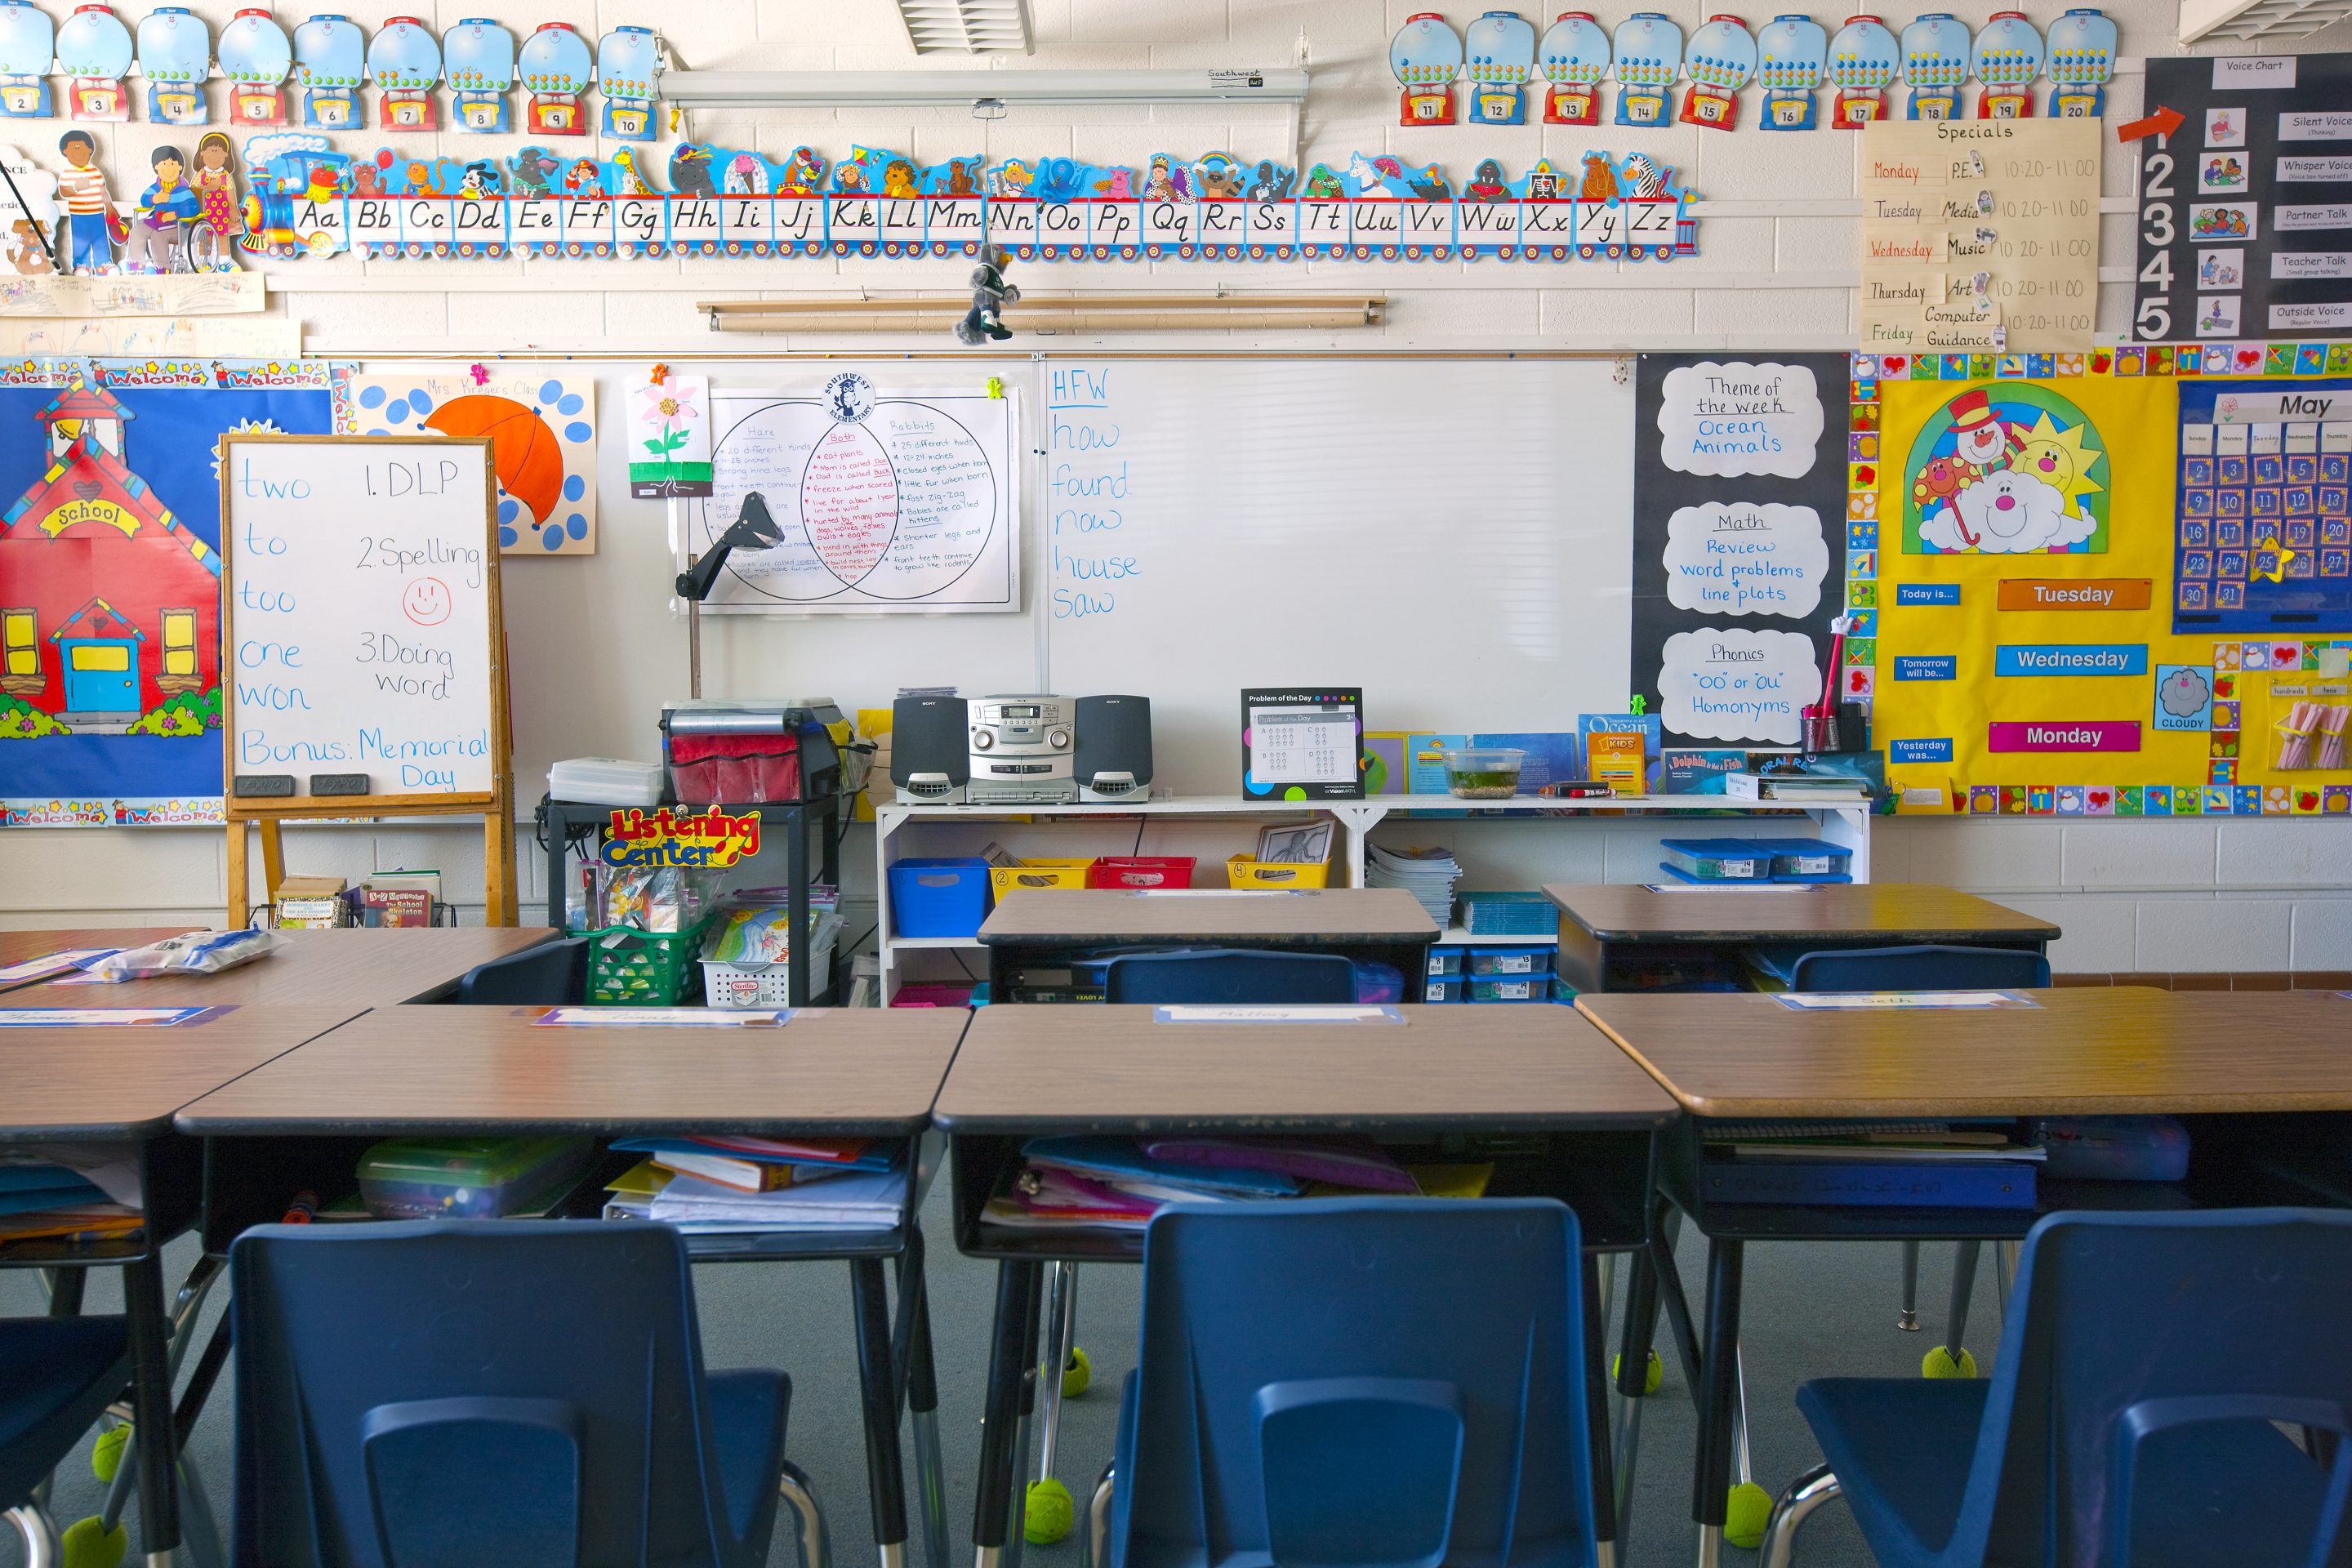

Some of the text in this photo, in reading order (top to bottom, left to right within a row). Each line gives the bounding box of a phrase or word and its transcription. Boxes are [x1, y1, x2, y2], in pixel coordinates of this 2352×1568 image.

[2226, 60, 2284, 71] Voice Chart
[17, 98, 25, 109] 2
[173, 105, 182, 116] 4
[1423, 105, 1433, 116] 11
[1565, 105, 1578, 116] 13
[2067, 105, 2083, 118] 20
[404, 111, 412, 122] 7
[1783, 111, 1794, 122] 16
[2292, 116, 2352, 127] Silent Voice
[622, 121, 635, 132] 10
[1937, 122, 2013, 143] Specials
[1873, 162, 1919, 185] Monday
[1952, 163, 1972, 179] P.E.
[2284, 161, 2326, 172] Whisper
[2145, 154, 2175, 198] 2
[1873, 200, 1980, 225] Tuesday Media
[2286, 209, 2348, 220] Partner Talk
[298, 200, 1673, 243] Aa Dd Gg Hh Jj Mm Pp Qq Tt Ww Zz
[2143, 203, 2175, 246] 3
[1871, 239, 1986, 263] Wednesday Music
[2282, 256, 2346, 266] Teacher Talk
[2139, 250, 2174, 292] 4
[1870, 279, 1972, 305] Thursday Art
[1925, 306, 1990, 325] Computer
[2136, 297, 2171, 341] 5
[2277, 306, 2345, 317] Outside Voice
[1873, 324, 1913, 345] Friday
[1927, 331, 1991, 349] Guidance
[109, 372, 202, 386] Welcome
[231, 372, 323, 386] Welcome
[825, 372, 870, 394] SOUTHWEST
[1054, 368, 1108, 400] HFW
[1705, 376, 1783, 396] Theme of
[1696, 397, 1786, 414] the week
[2279, 394, 2333, 417] May
[747, 425, 776, 438] Hare
[890, 421, 935, 432] Rabbits
[1054, 413, 1120, 451] how
[1699, 420, 1767, 436] Ocean
[830, 433, 856, 443] Both
[1692, 435, 1783, 454] Animals
[237, 457, 311, 500] two
[1052, 460, 1133, 499] found
[2195, 466, 2203, 478] 2
[2224, 493, 2340, 510] 10 13
[58, 502, 119, 524] School
[1718, 513, 1767, 529] Math
[1055, 510, 1122, 535] now
[2328, 523, 2344, 537] 20
[243, 522, 287, 555] to
[1707, 539, 1776, 555] Review
[1054, 545, 1142, 580] house
[2190, 558, 2205, 570] 23
[1680, 559, 1804, 584] word problems
[237, 580, 296, 613] too
[1702, 586, 1786, 608] line plots
[1902, 589, 1953, 600] Today is...
[2034, 586, 2115, 606] Tuesday
[2221, 588, 2236, 601] 31
[239, 639, 304, 668] one
[1712, 643, 1765, 661] Phonics
[2017, 651, 2130, 670] Wednesday
[1902, 658, 1949, 668] Tomorrow
[1906, 669, 1922, 677] will
[1734, 679, 1748, 689] or
[2274, 686, 2337, 695] hundreds tens
[238, 682, 311, 710] won
[1298, 695, 1312, 703] Day
[1693, 697, 1791, 721] Homonyms
[1589, 716, 1647, 735] Ocean
[2162, 719, 2204, 728] CLOUDY
[243, 727, 488, 764] Bonus: Memorial
[1609, 739, 1635, 749] KIDS
[2027, 727, 2103, 747] Monday
[1897, 742, 1946, 752] Yesterday
[1672, 755, 1743, 771] Dolphin Fish
[402, 764, 456, 793] Day
[11, 810, 101, 825] Welcome
[611, 805, 760, 856] Listening
[602, 838, 715, 866] Center
[388, 907, 423, 915] Skeleton
